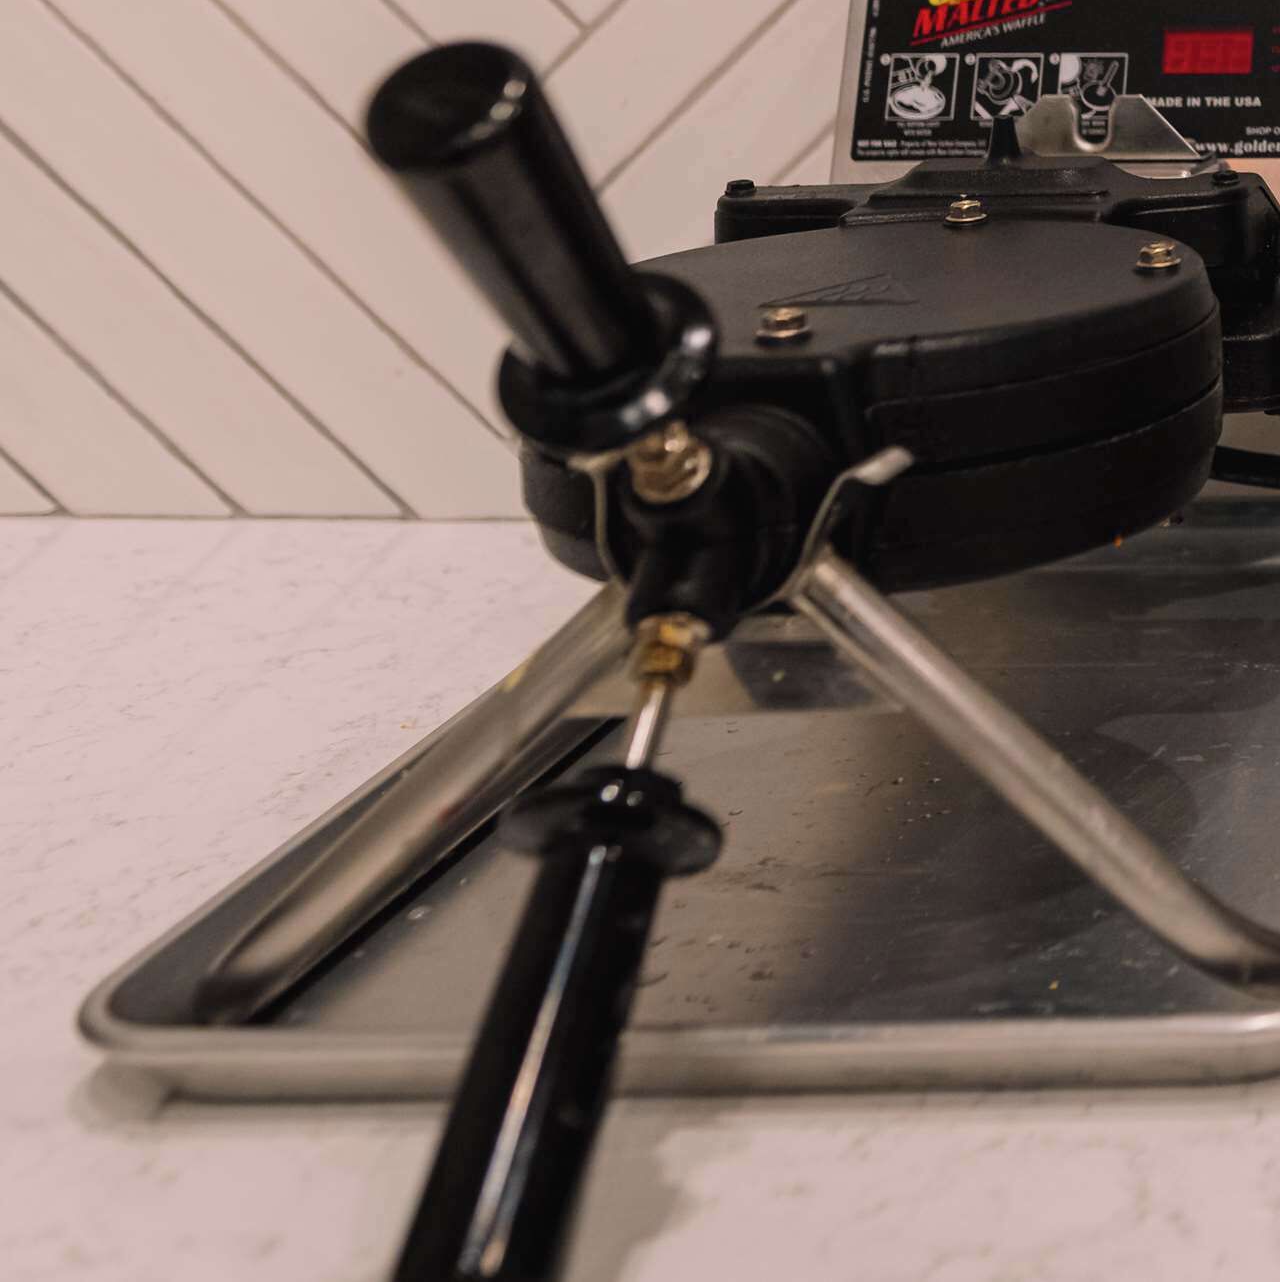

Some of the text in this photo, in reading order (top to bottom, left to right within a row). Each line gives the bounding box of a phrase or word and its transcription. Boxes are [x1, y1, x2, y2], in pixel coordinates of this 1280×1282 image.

[1187, 96, 1200, 107] IN
[1205, 96, 1231, 107] THE
[1234, 96, 1262, 107] USA
[1246, 125, 1271, 135] SHOP
